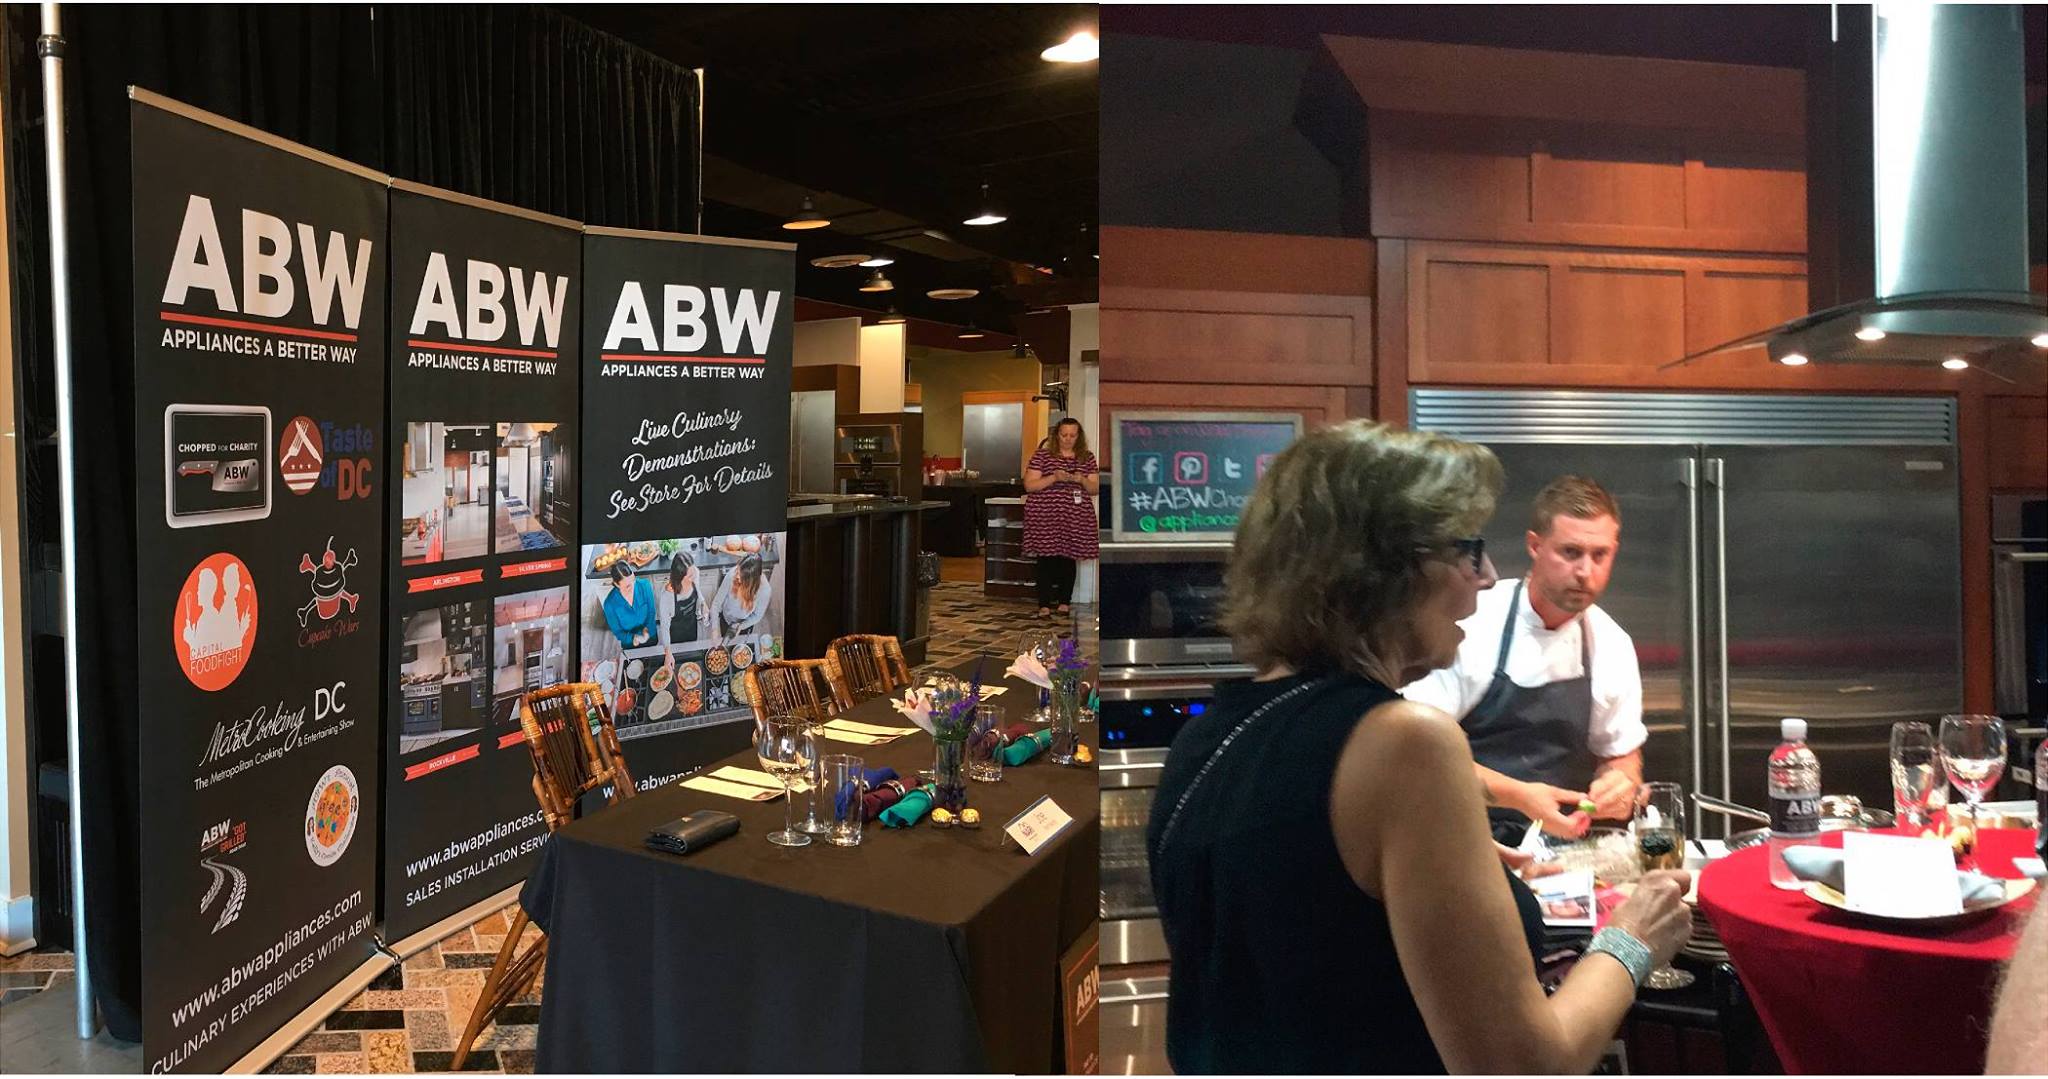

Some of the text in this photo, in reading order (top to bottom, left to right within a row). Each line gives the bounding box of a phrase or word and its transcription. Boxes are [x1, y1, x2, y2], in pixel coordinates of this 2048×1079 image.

[162, 195, 373, 329] ABW
[409, 251, 568, 349] ABW
[602, 281, 781, 355] ABW
[161, 328, 357, 364] APPLIANCES A BETTER WAY
[408, 353, 557, 375] APPLIANCES A BETTER WAY
[601, 364, 765, 379] APPLIANCES A BETTER WAY
[320, 421, 374, 452] Taste
[632, 408, 743, 445] Live Culinary
[178, 443, 217, 453] CHOPPED
[229, 442, 258, 452] CHARITY
[622, 439, 756, 482] Demonstrations:
[224, 466, 249, 480] ABW
[338, 458, 372, 500] DC
[606, 463, 774, 519] See Store For Details
[1128, 486, 1249, 511] #ABWCho
[190, 648, 242, 676] FOODFIGHT
[315, 681, 346, 721] DC
[194, 777, 209, 791] The
[255, 747, 283, 765] Cooking
[201, 818, 230, 847] ABW
[406, 809, 543, 877] www.abwappliances.c
[406, 880, 441, 907] SALES
[444, 845, 518, 889] INSTALLATION
[172, 889, 361, 1028] www.abwappliances.com
[151, 911, 372, 1074] CULINARY EXPERIENCES WITH ABW
